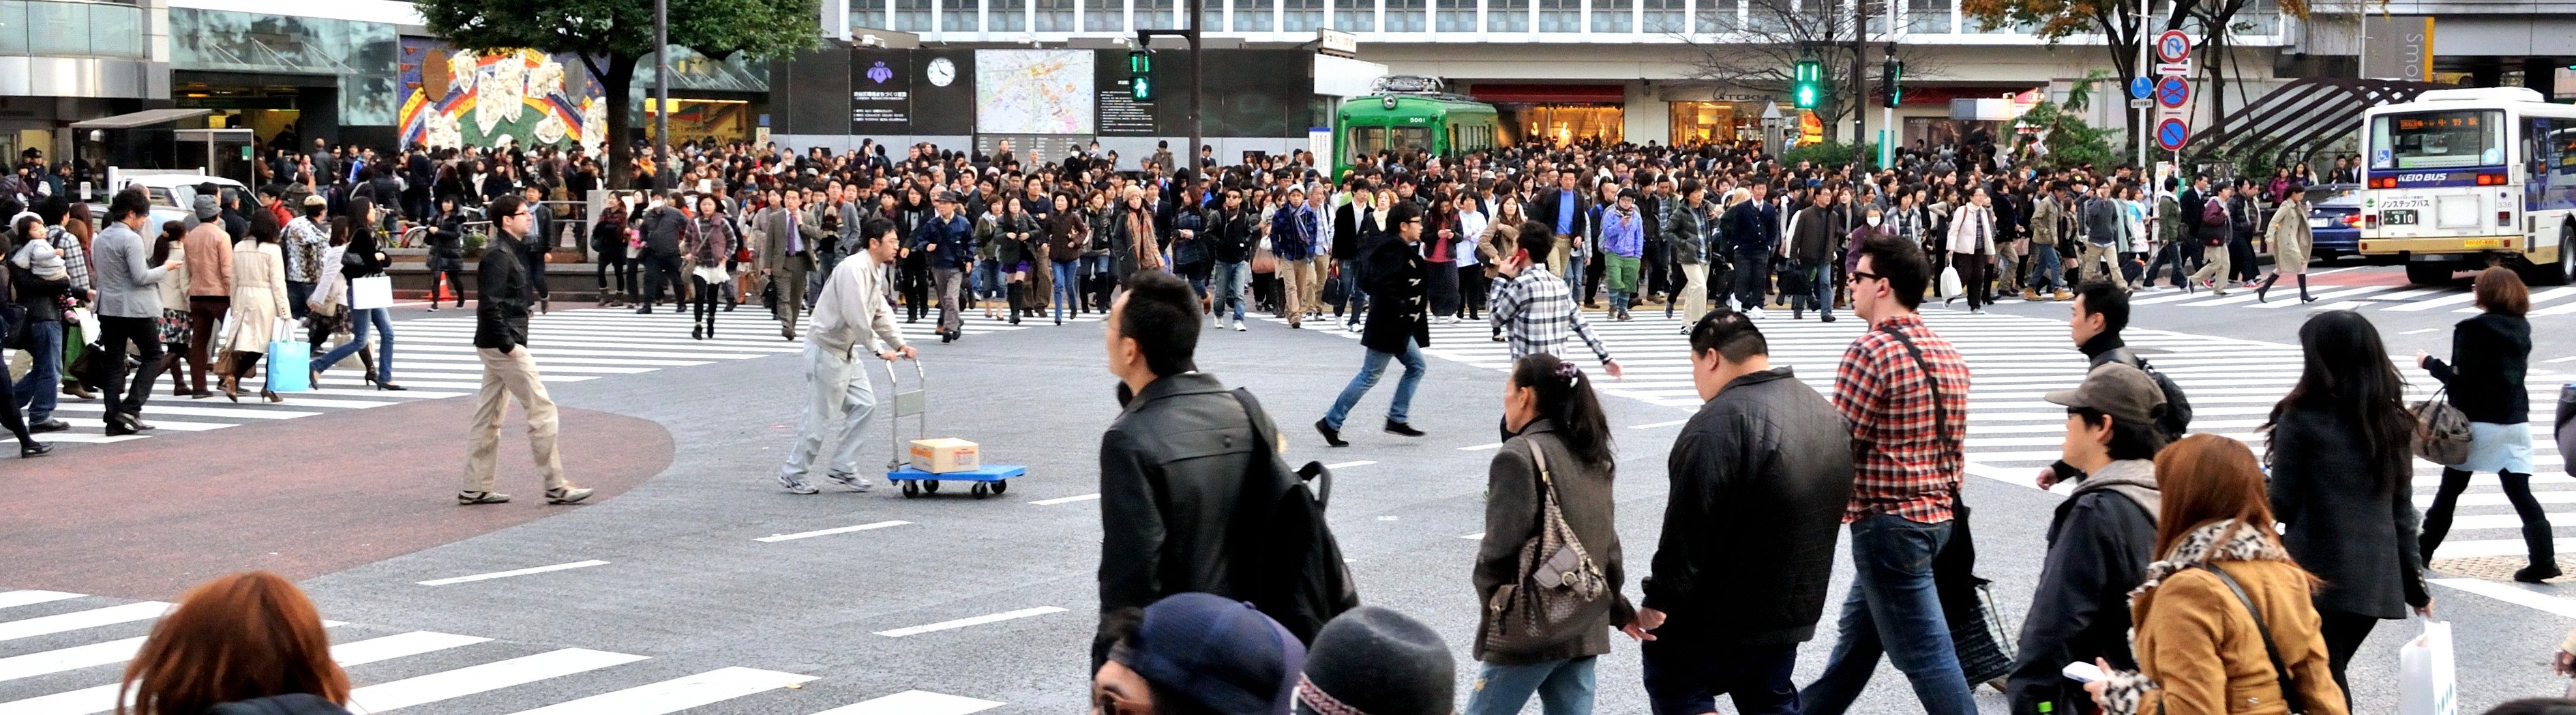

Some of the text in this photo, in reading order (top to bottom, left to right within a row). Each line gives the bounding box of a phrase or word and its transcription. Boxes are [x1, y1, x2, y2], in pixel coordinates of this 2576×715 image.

[2405, 33, 2423, 81] Smo
[2424, 173, 2447, 181] BUS
[2382, 200, 2429, 208] ノンステップバス
